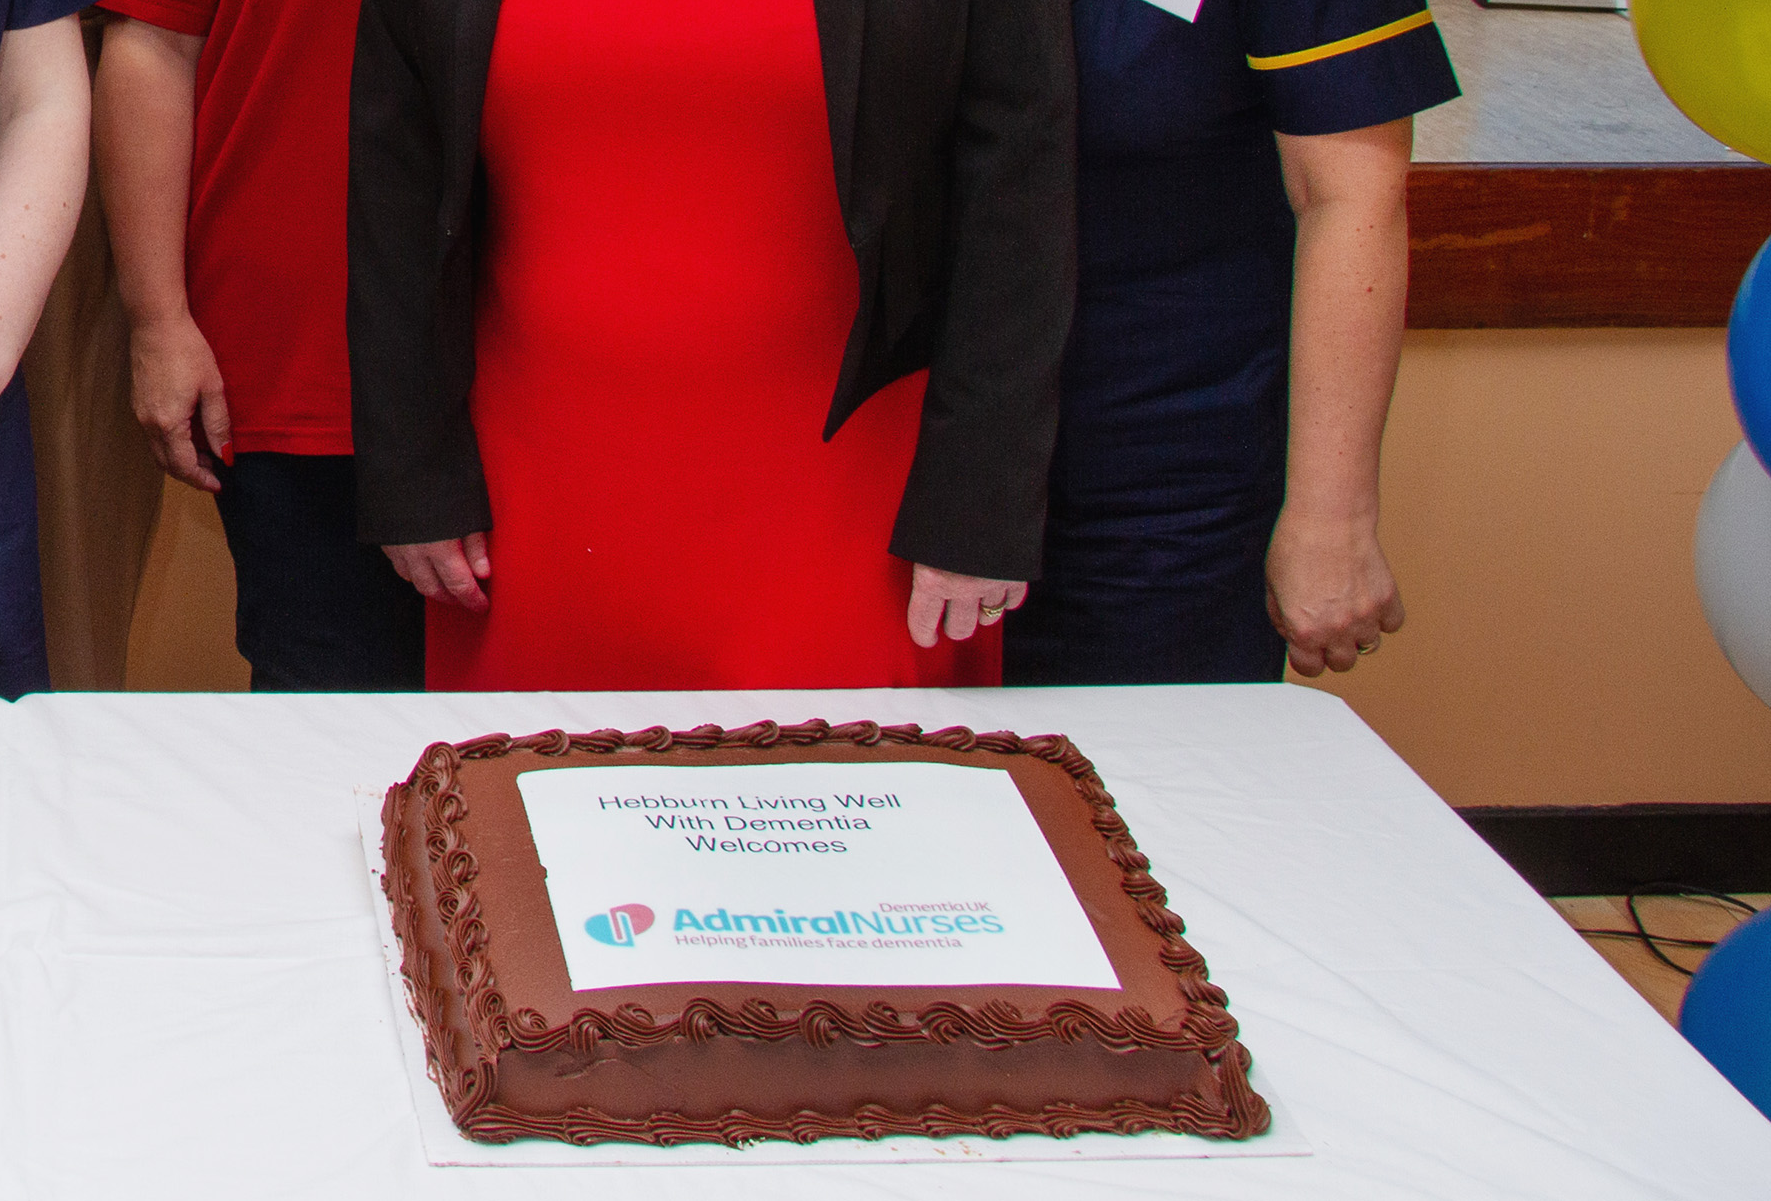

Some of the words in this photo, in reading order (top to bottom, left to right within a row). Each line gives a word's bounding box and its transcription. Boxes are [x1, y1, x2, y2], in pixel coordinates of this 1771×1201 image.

[598, 795, 729, 810] Hebburn
[737, 795, 826, 812] Living
[833, 793, 902, 808] Well
[645, 814, 715, 830] With
[724, 815, 872, 831] Dementia
[685, 834, 848, 853] Welcomes
[675, 934, 748, 949] Helping
[750, 935, 825, 949] families
[826, 936, 869, 948] face
[871, 936, 963, 949] dementia
